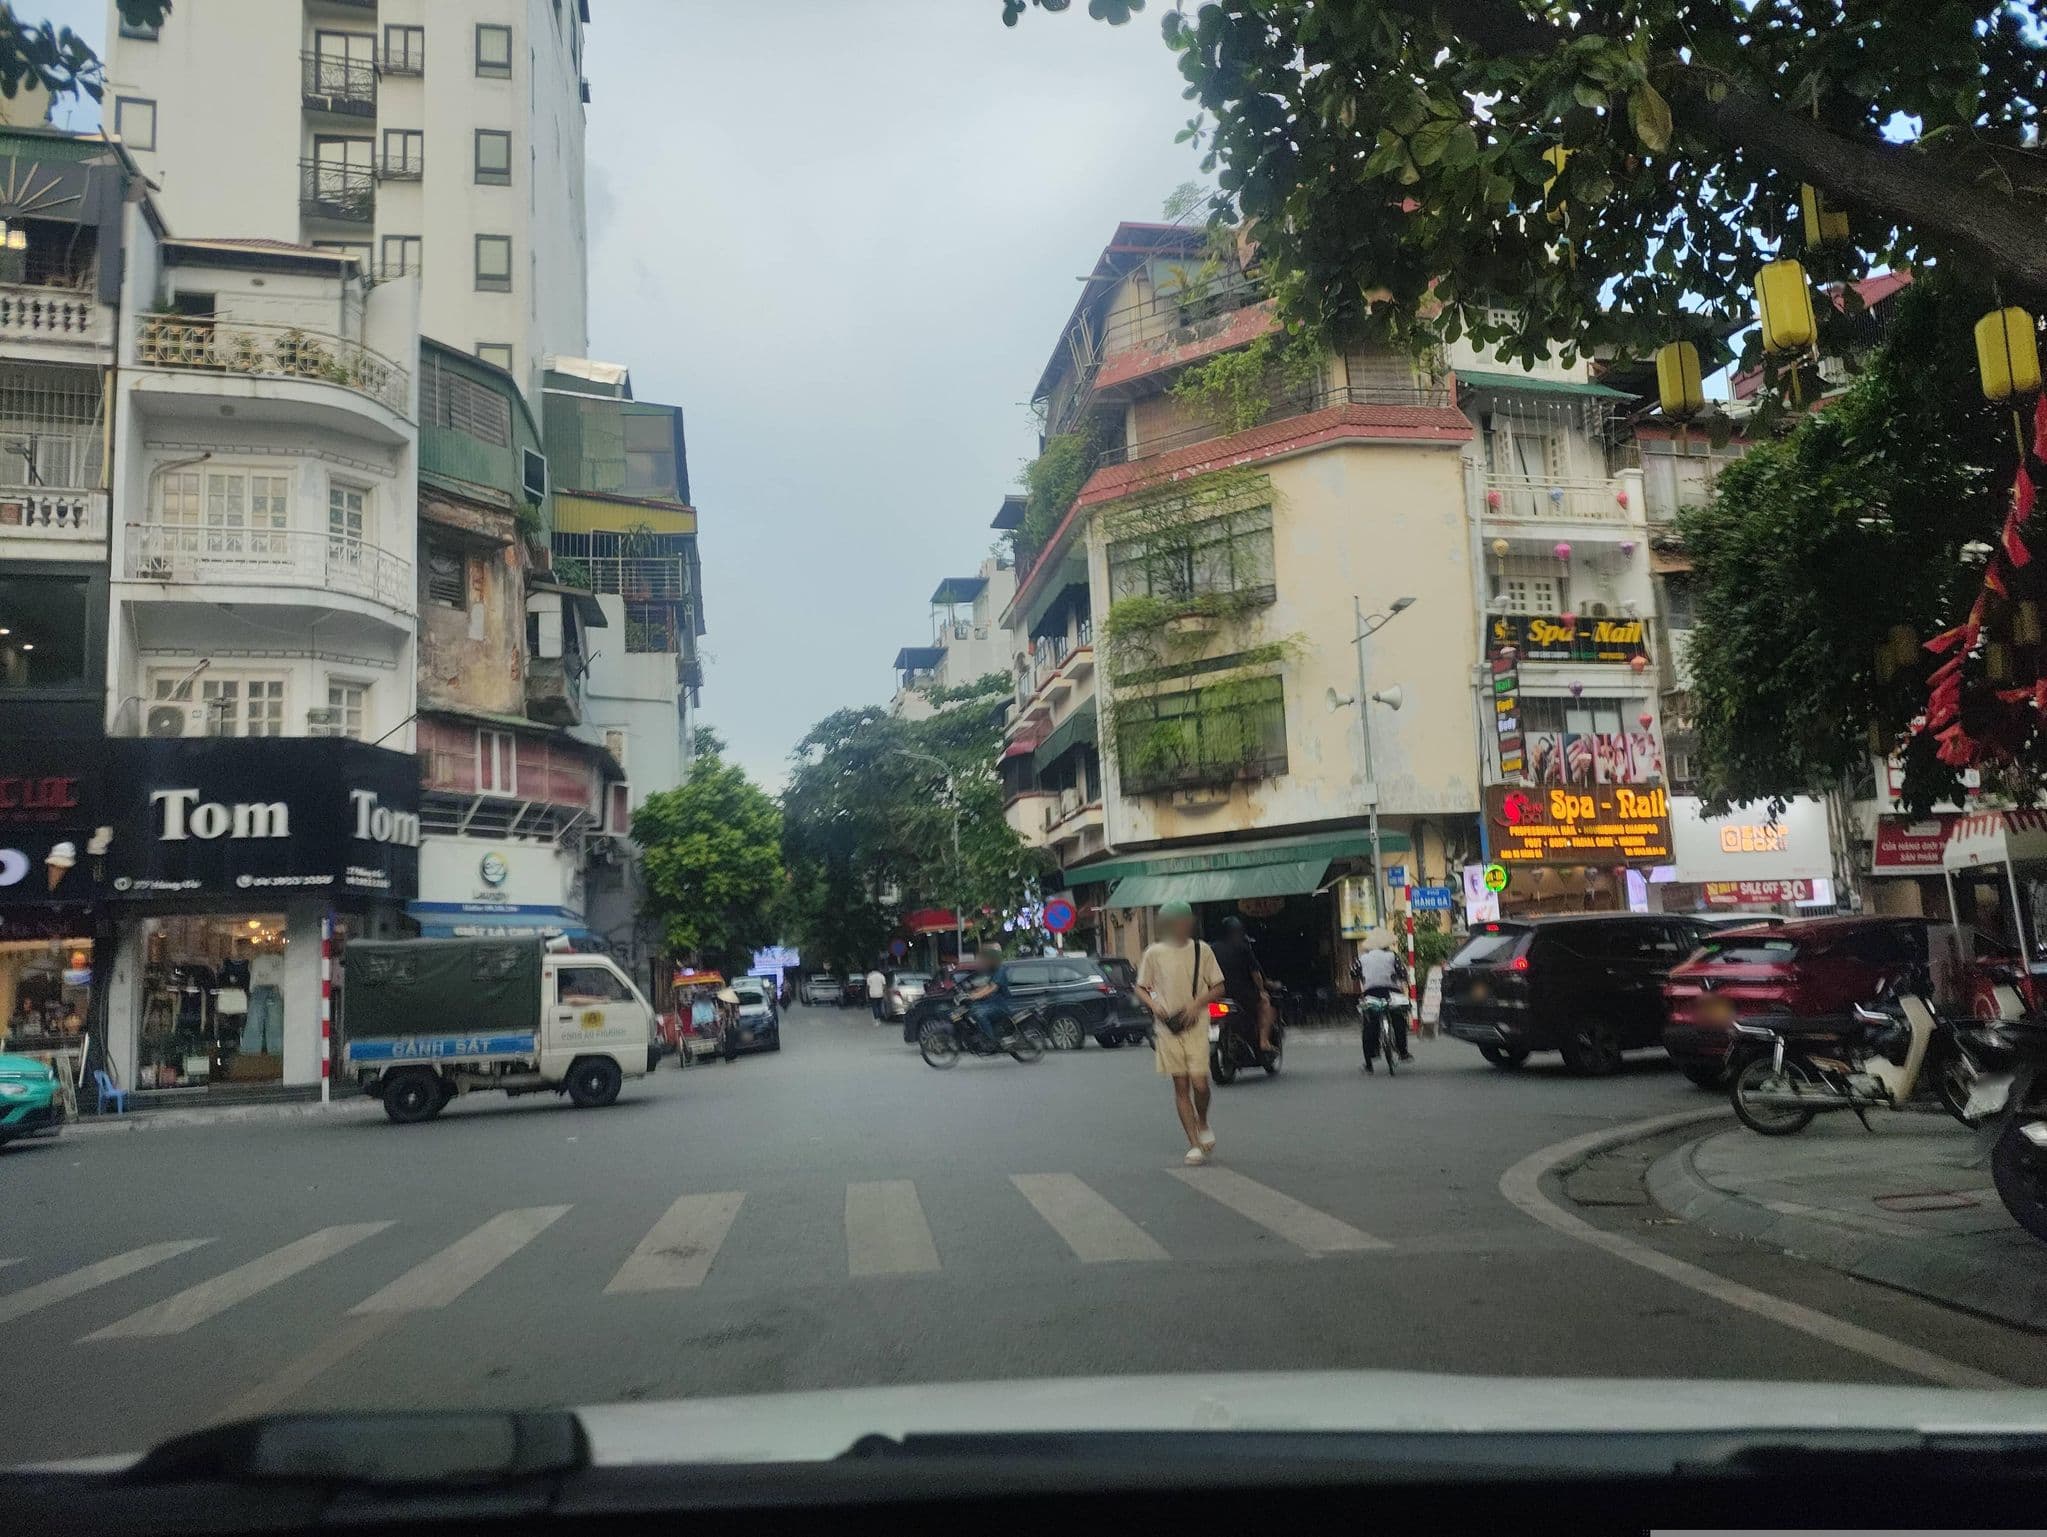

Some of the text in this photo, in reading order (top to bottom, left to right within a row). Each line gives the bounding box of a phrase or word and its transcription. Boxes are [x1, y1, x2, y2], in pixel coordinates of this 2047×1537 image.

[1528, 619, 1574, 646] Spa
[1593, 621, 1643, 643] Nail
[150, 788, 292, 840] Tom
[350, 788, 420, 848] Tom
[1550, 789, 1596, 824] Spa
[1615, 787, 1667, 819] Nail
[1740, 881, 1762, 895] SALE
[1762, 881, 1780, 895] OFF
